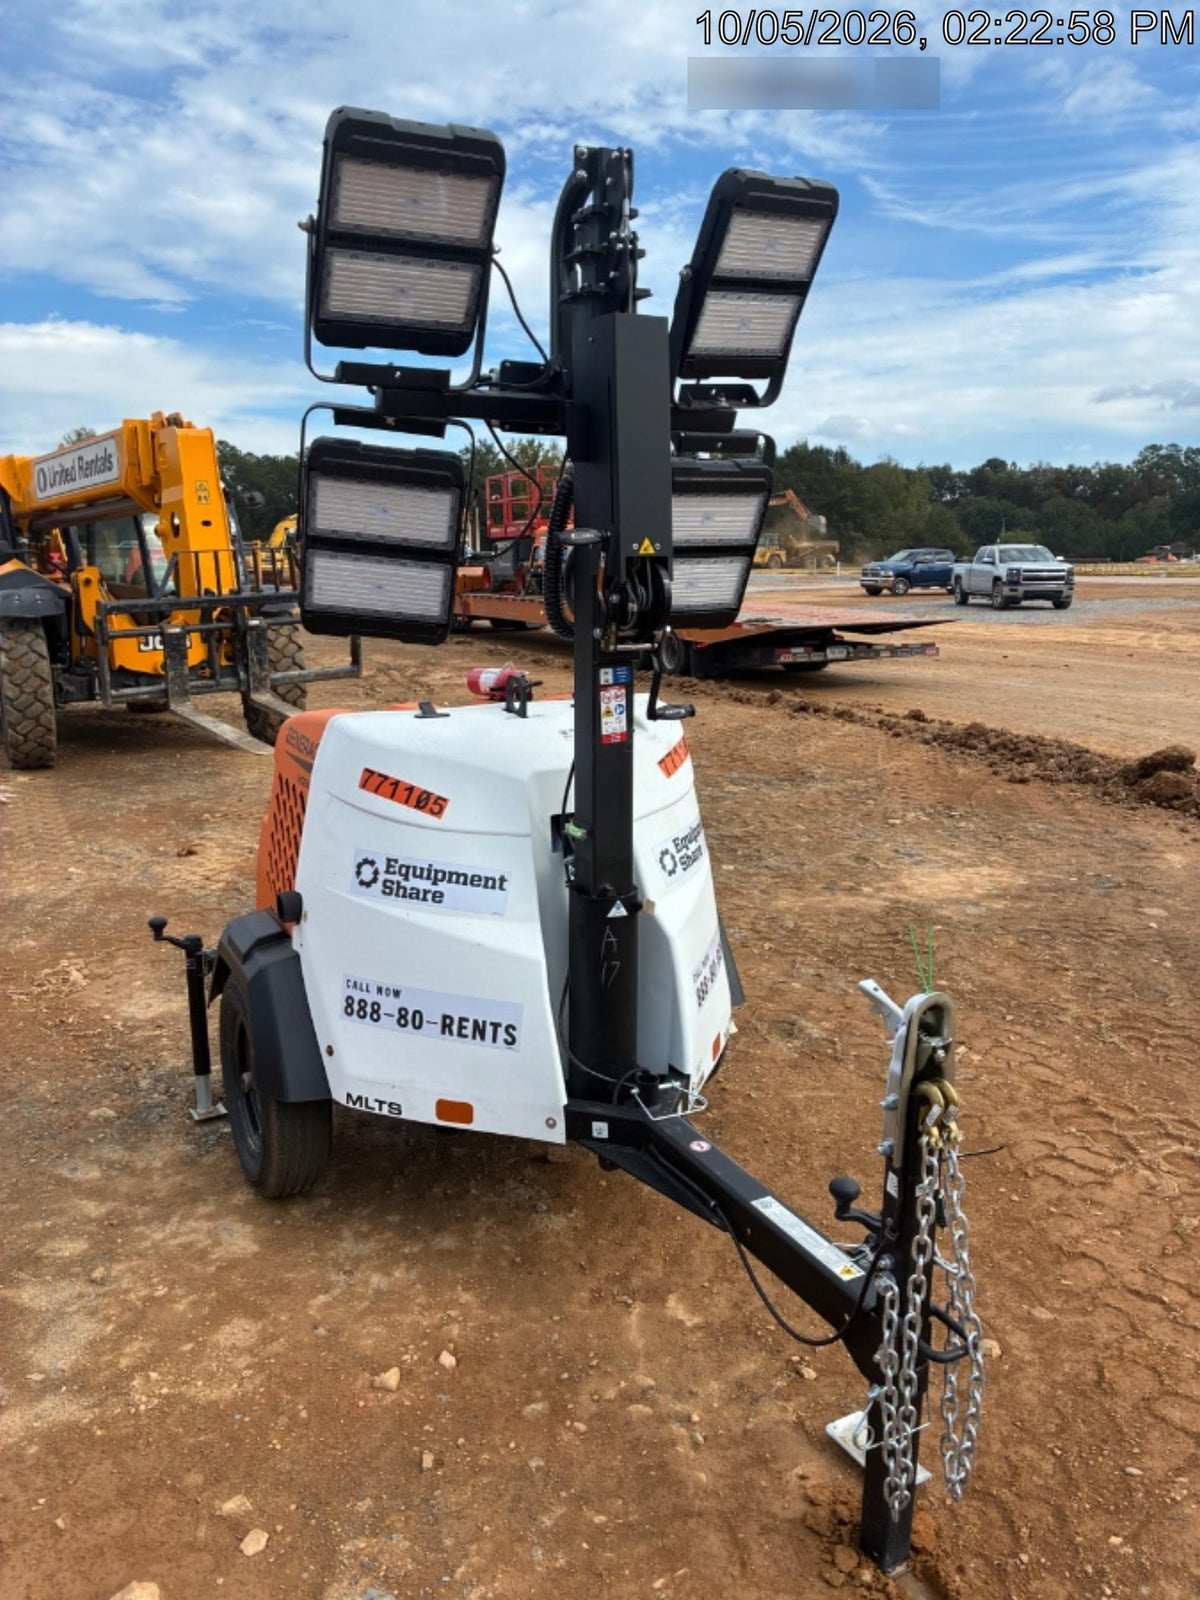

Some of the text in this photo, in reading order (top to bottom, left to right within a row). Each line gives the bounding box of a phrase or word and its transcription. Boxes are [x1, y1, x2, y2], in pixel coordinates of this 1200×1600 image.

[48, 447, 114, 488] United Rentals
[139, 634, 191, 651] JC
[361, 769, 448, 816] 771105
[384, 857, 508, 892] Equipment
[381, 880, 445, 904] Share
[346, 979, 402, 999] CALL NOW
[344, 995, 518, 1047] 888-80-RENTS
[346, 1092, 403, 1116] MLTS
